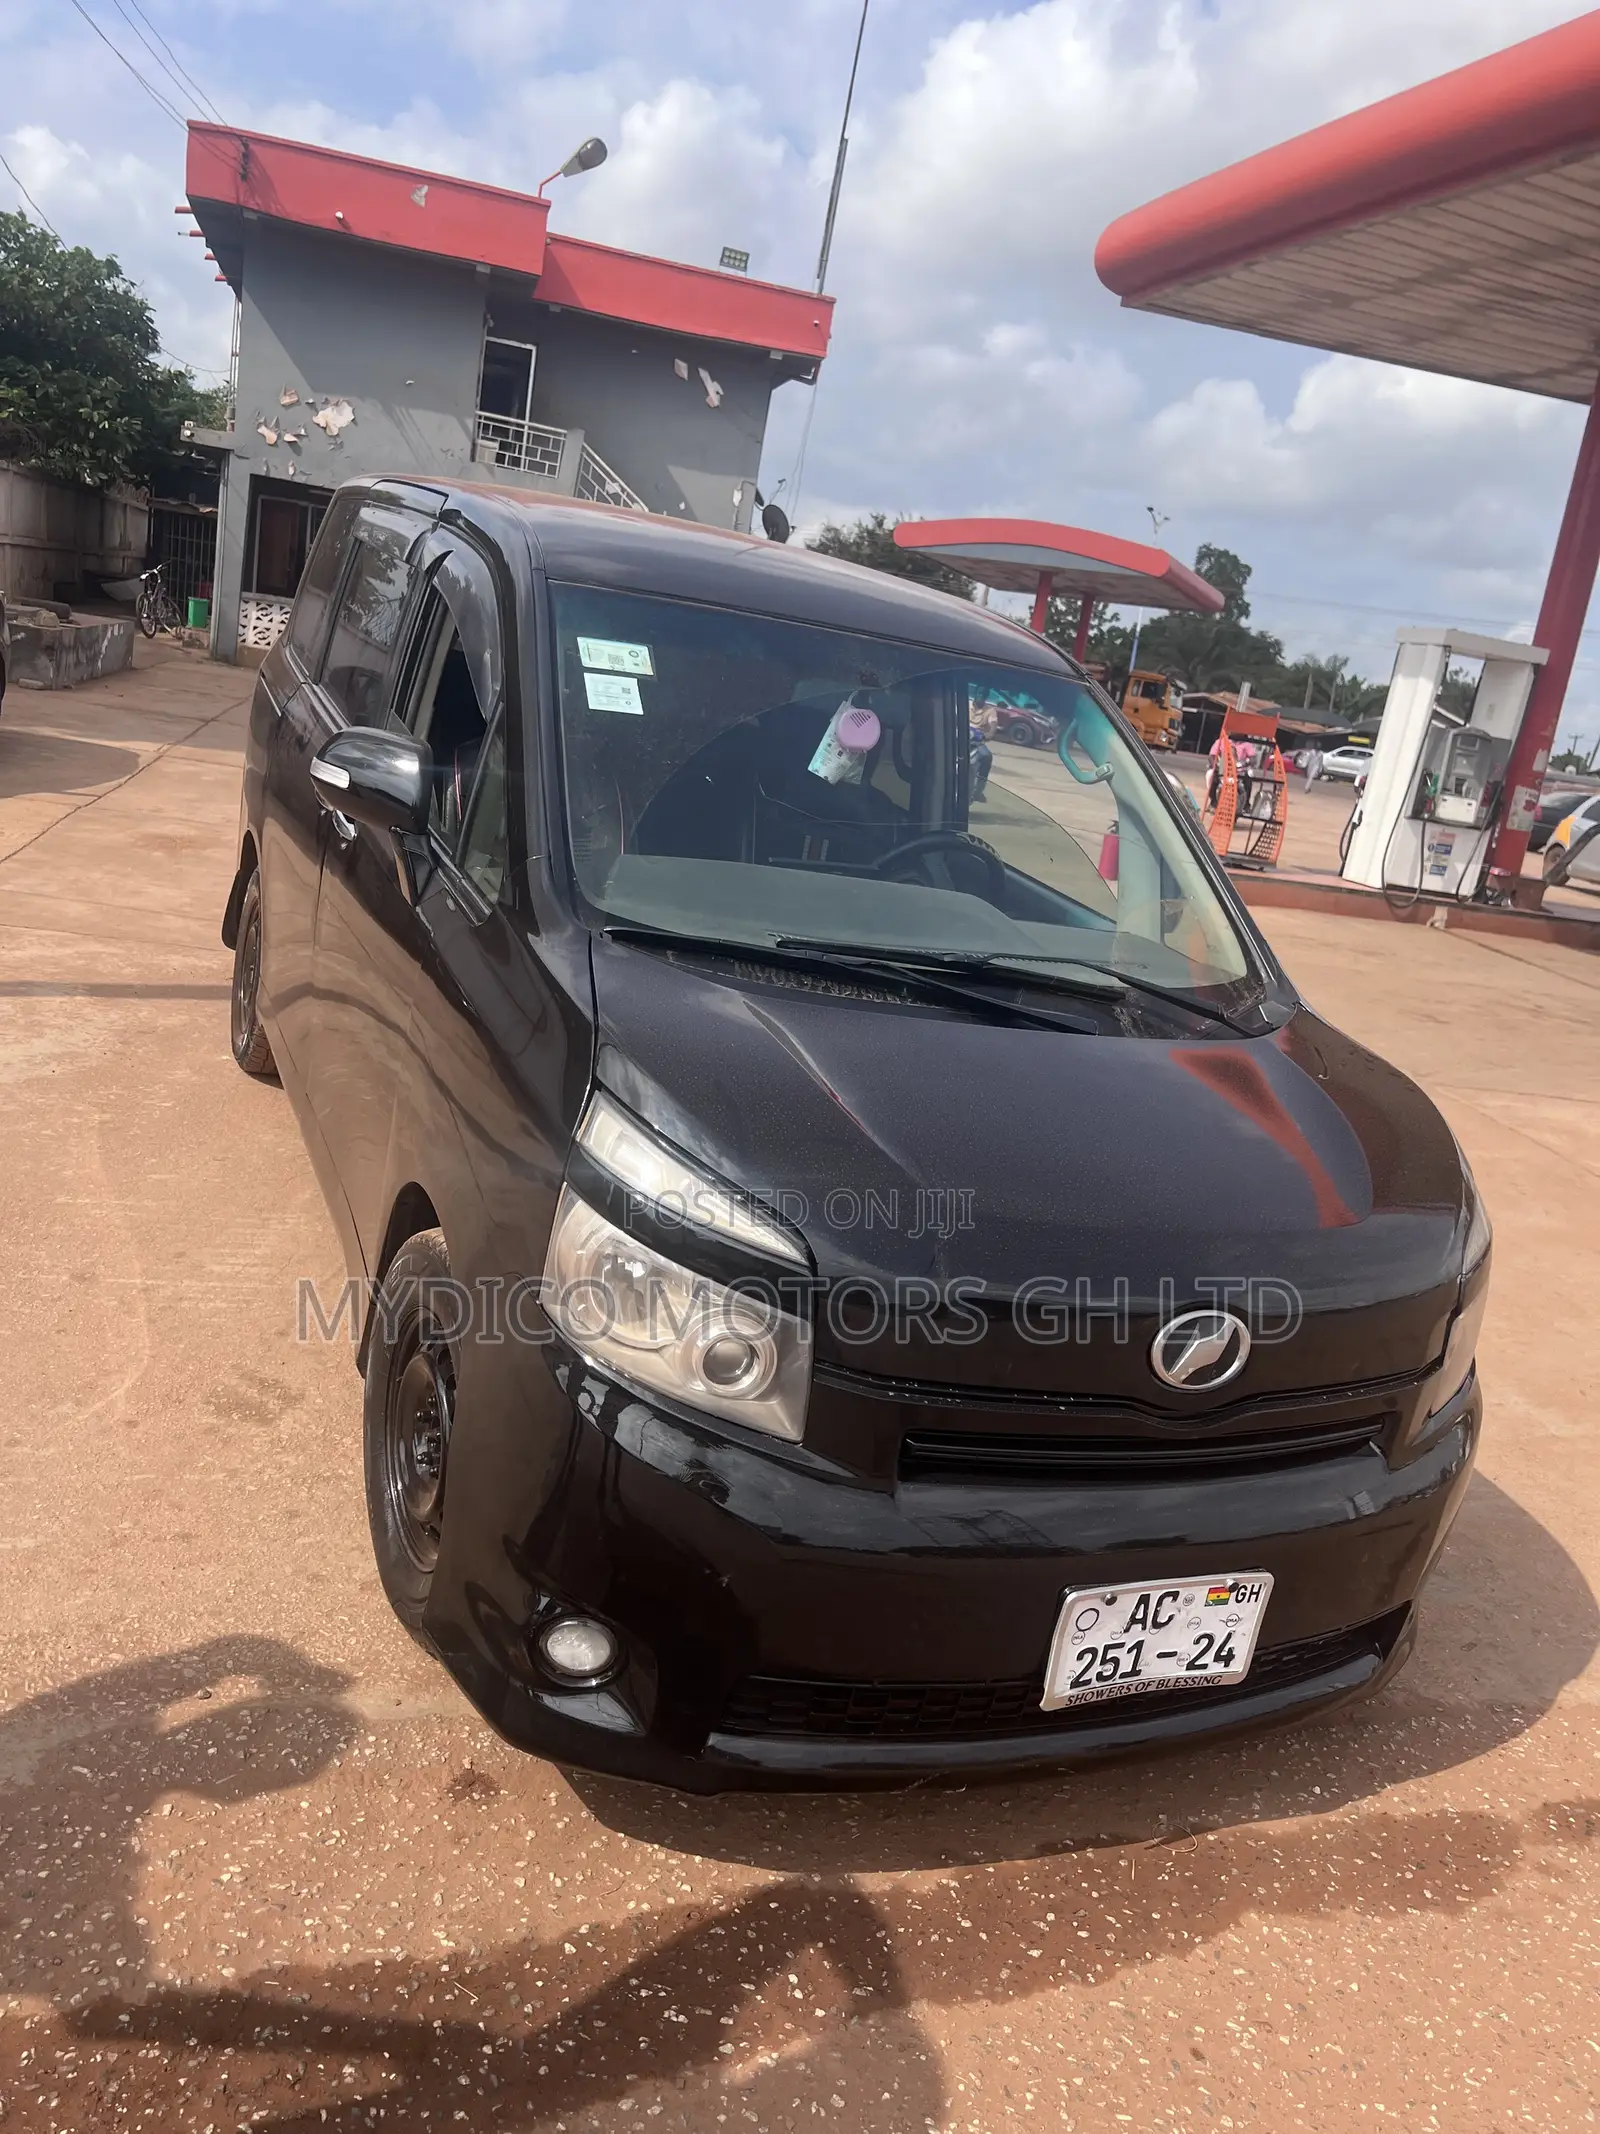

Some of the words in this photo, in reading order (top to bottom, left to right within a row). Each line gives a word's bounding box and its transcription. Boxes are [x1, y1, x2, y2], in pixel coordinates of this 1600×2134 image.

[1235, 1584, 1262, 1604] GH
[1123, 1590, 1180, 1633] AC
[1065, 1684, 1132, 1706] SHOWERS
[1135, 1680, 1156, 1692] OF
[1156, 1675, 1223, 1690] BLESSING
